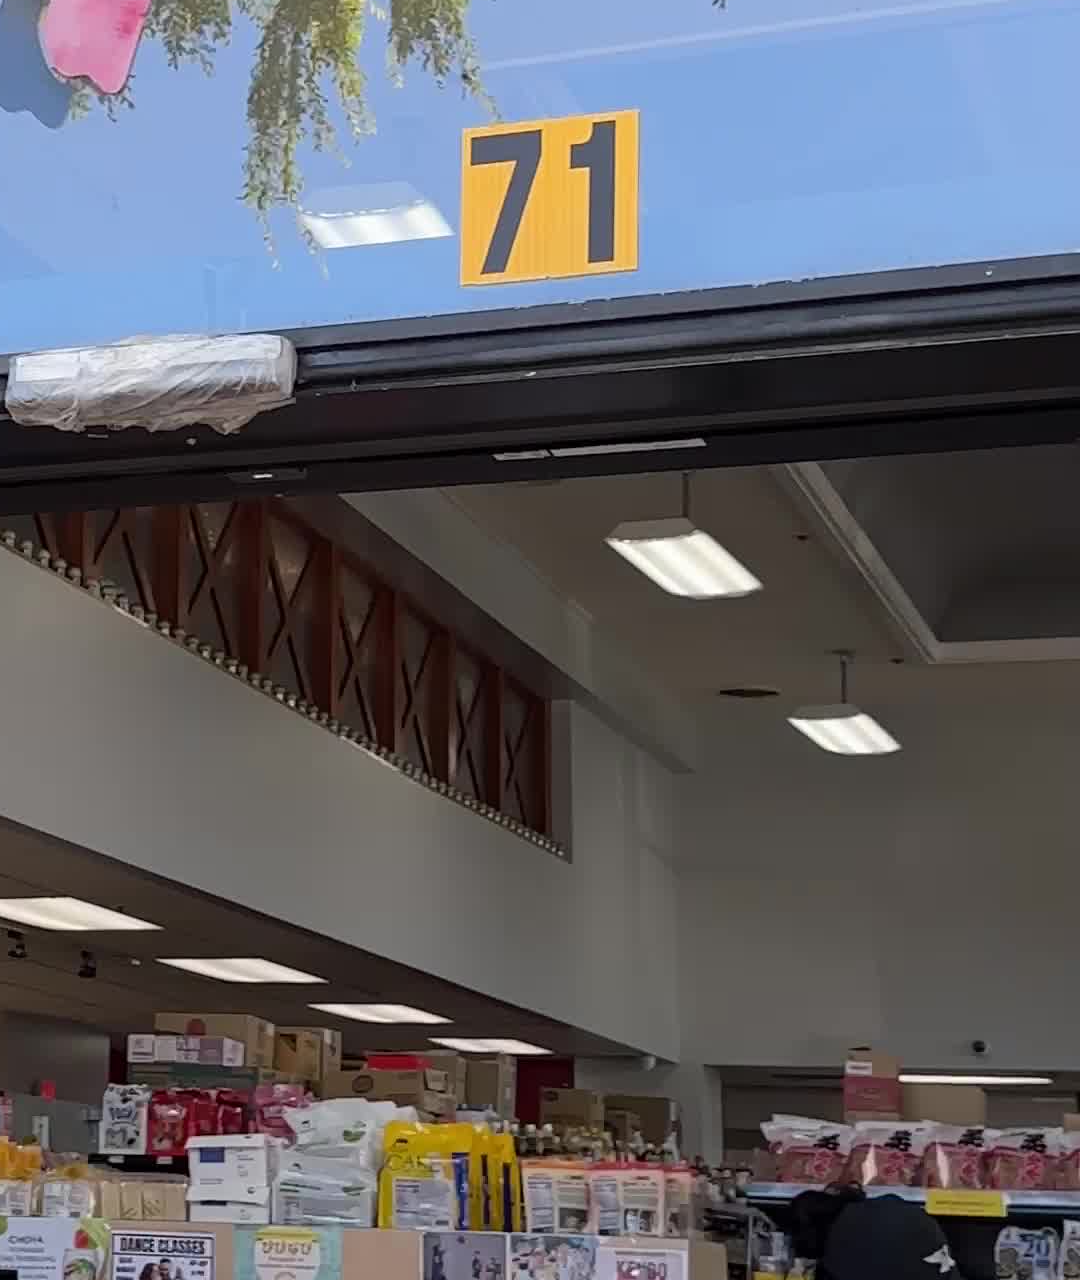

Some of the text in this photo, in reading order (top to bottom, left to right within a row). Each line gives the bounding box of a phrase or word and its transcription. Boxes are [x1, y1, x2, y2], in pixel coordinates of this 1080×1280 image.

[468, 119, 617, 276] 71
[120, 1237, 205, 1255] DANCE CLASSES
